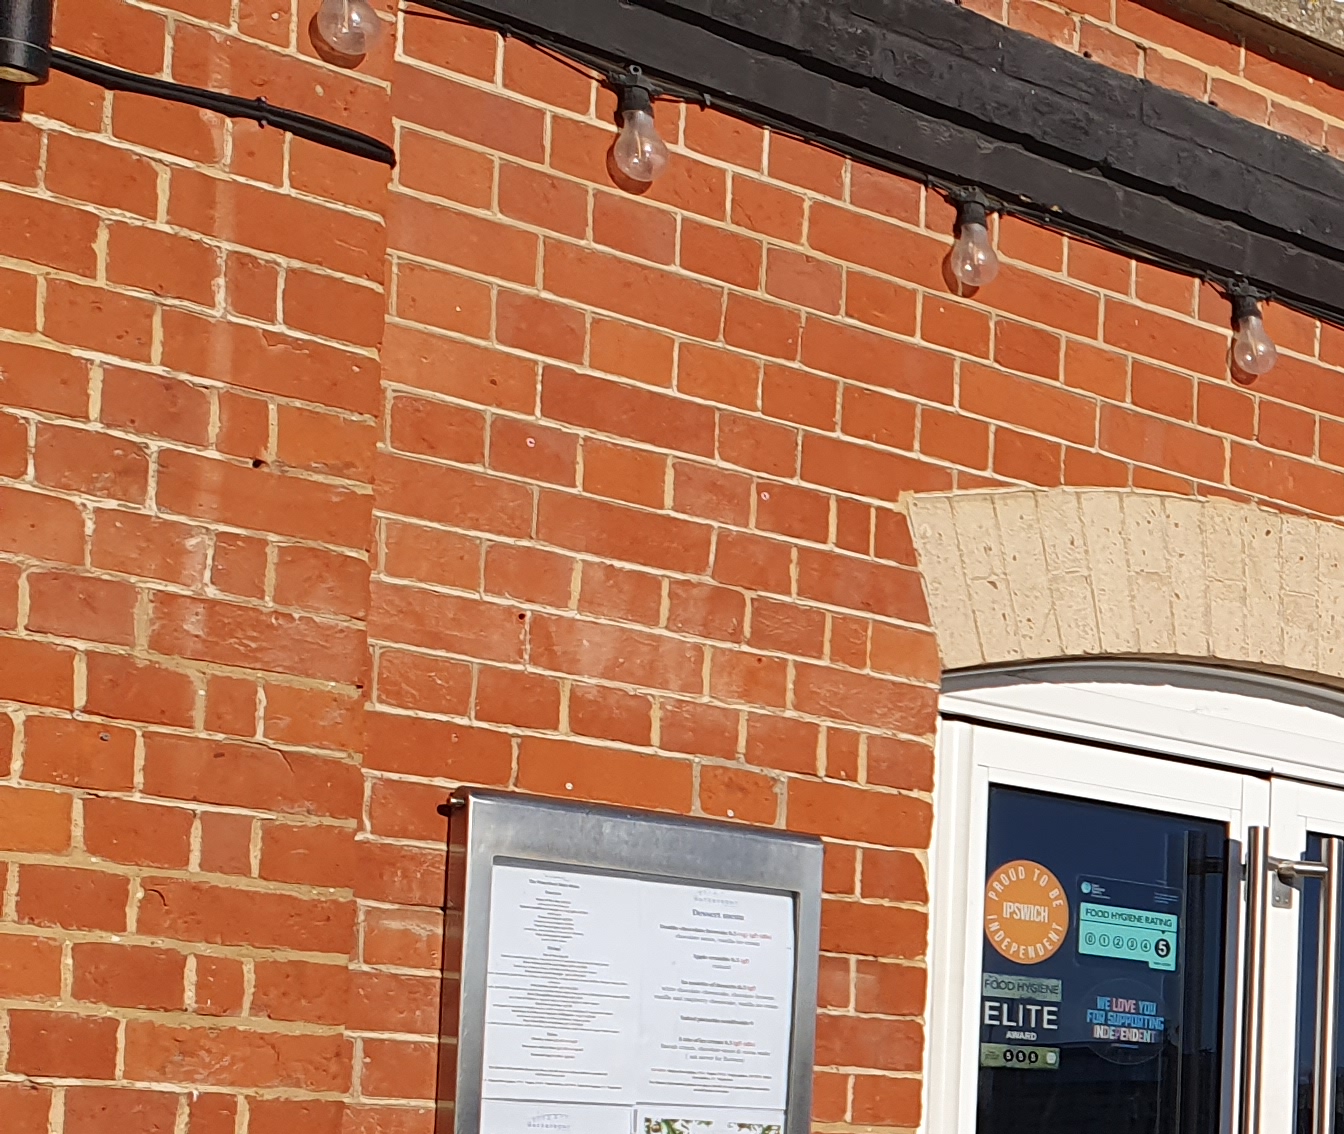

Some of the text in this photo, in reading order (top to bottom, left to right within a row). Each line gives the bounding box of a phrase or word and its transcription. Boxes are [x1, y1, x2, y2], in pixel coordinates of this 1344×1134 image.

[988, 866, 1064, 908] PROUD TO BE
[1003, 901, 1049, 923] IPSWICH
[1085, 908, 1172, 928] FOOD HYGIENE RATING
[987, 914, 1064, 959] INDEPENDENT
[1158, 941, 1167, 956] 5
[984, 978, 1059, 995] FOOD HYGIENE
[984, 1001, 1058, 1030] ELITE
[1096, 996, 1157, 1015] WE LOVE YOU
[1086, 1009, 1165, 1030] FOR SUPPORTING
[1006, 1030, 1037, 1041] AWARD
